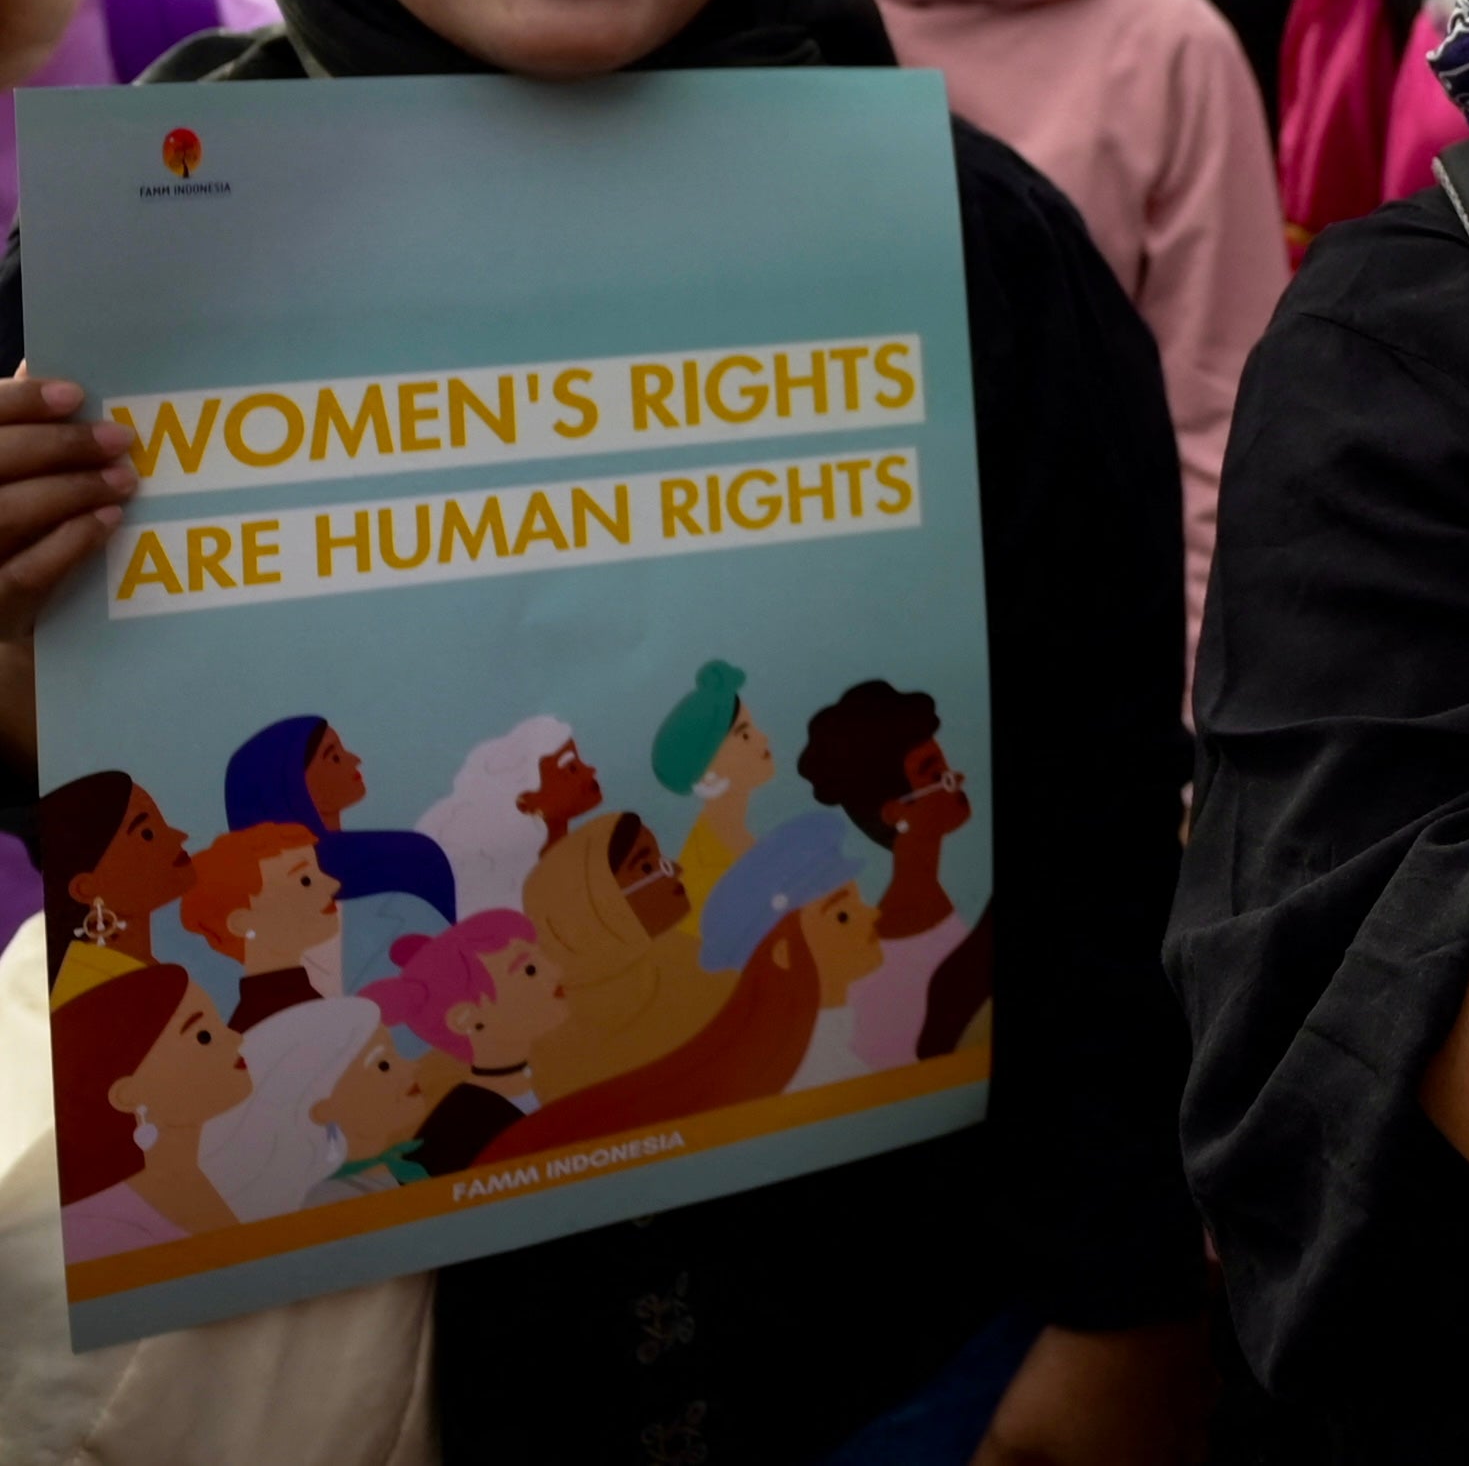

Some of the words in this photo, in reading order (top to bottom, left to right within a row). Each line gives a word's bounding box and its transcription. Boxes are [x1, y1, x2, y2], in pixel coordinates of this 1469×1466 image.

[139, 185, 170, 198] FAMM
[174, 181, 231, 195] INDONESIA
[110, 367, 599, 478] WOMEN'S
[630, 342, 915, 432] RIGHTS
[115, 519, 281, 601] ARE
[315, 482, 631, 578] HUMAN
[660, 455, 913, 539] RIGHTS
[452, 1165, 540, 1202] FAMM
[546, 1131, 686, 1178] INDONESIA
